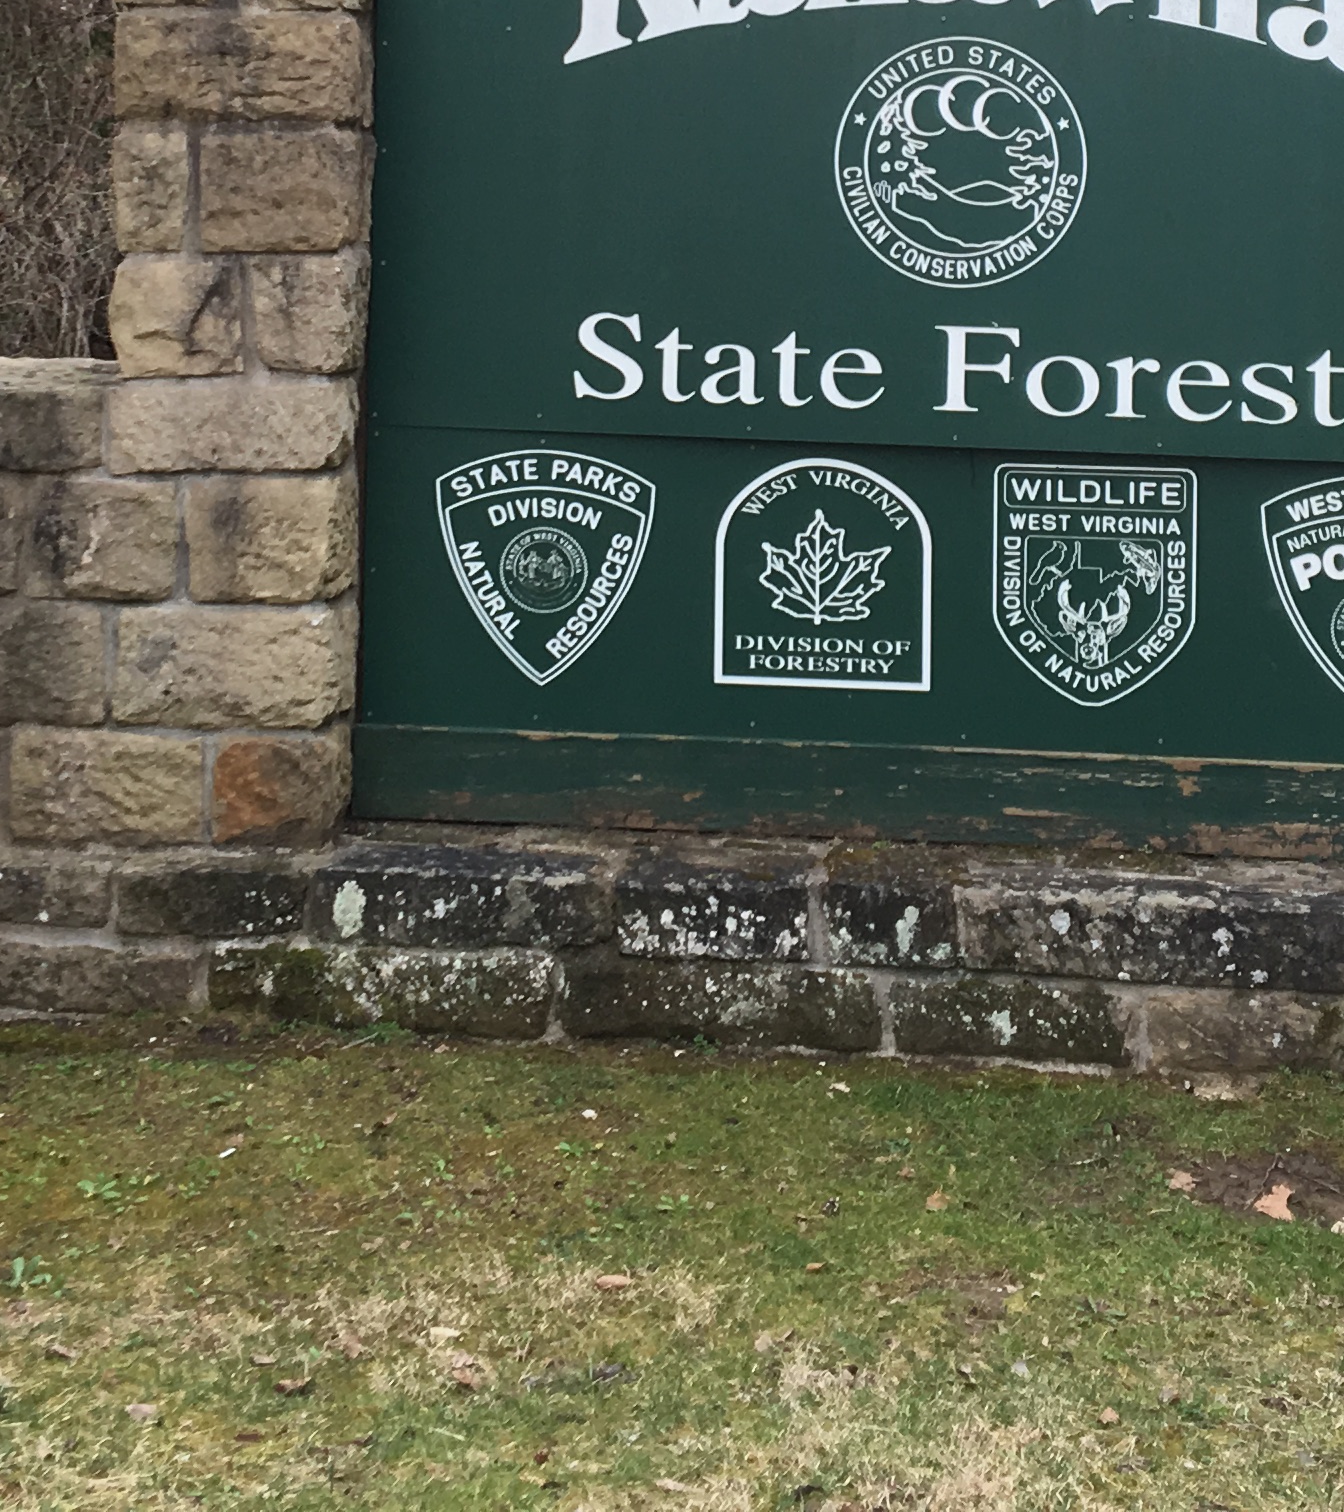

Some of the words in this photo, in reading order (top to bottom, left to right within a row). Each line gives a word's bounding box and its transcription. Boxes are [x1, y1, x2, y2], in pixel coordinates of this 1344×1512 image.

[867, 45, 954, 100] UNITED
[968, 46, 1056, 105] STATES
[843, 166, 891, 245] CIVILIAN
[889, 236, 1038, 279] CONSERVATION
[1037, 173, 1078, 239] CORPS
[573, 311, 886, 410] State
[451, 459, 539, 497] STATE
[551, 459, 641, 503] PARKS
[741, 473, 798, 517] WEST
[808, 470, 910, 531] VIRGINIA
[1011, 478, 1182, 506] WILDLIFE
[487, 497, 603, 530] DIVISION
[1009, 513, 1071, 531] WEST
[1081, 515, 1181, 535] VIRGINIA
[459, 541, 521, 640] NATURAL
[545, 533, 633, 659] RESOURCES
[1003, 536, 1025, 627] DIVISION
[1019, 630, 1047, 653] OF
[1044, 653, 1142, 693] NATURAL
[1137, 540, 1186, 664] RESOURCES
[735, 634, 864, 654] DIVISION
[872, 639, 911, 656] OF
[749, 654, 895, 674] FORESTRY
